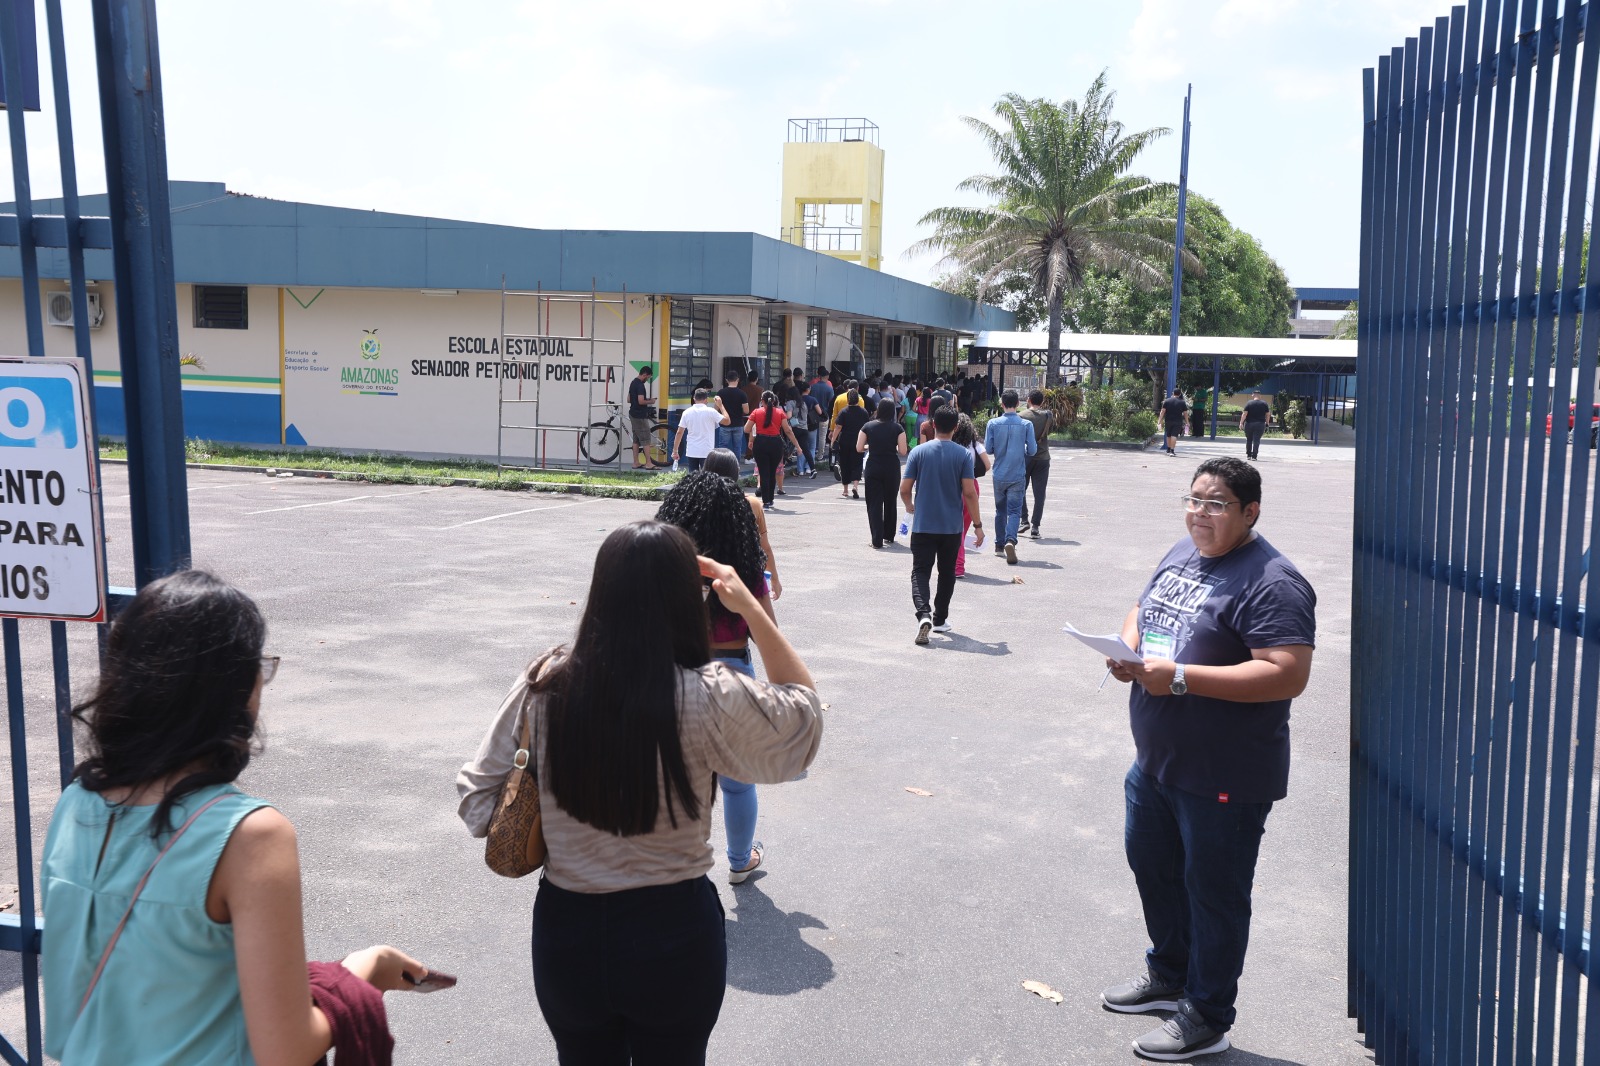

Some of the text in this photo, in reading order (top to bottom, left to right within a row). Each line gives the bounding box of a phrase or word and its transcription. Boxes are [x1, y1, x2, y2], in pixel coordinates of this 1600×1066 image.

[448, 336, 574, 357] ESCOLA ESTADUAL
[340, 366, 399, 385] AMAZONAS
[411, 356, 616, 384] SENADOR PETRÔNIO PORTELA
[0, 468, 65, 506] NTO
[0, 519, 85, 547] PARA
[0, 564, 50, 601] IOS
